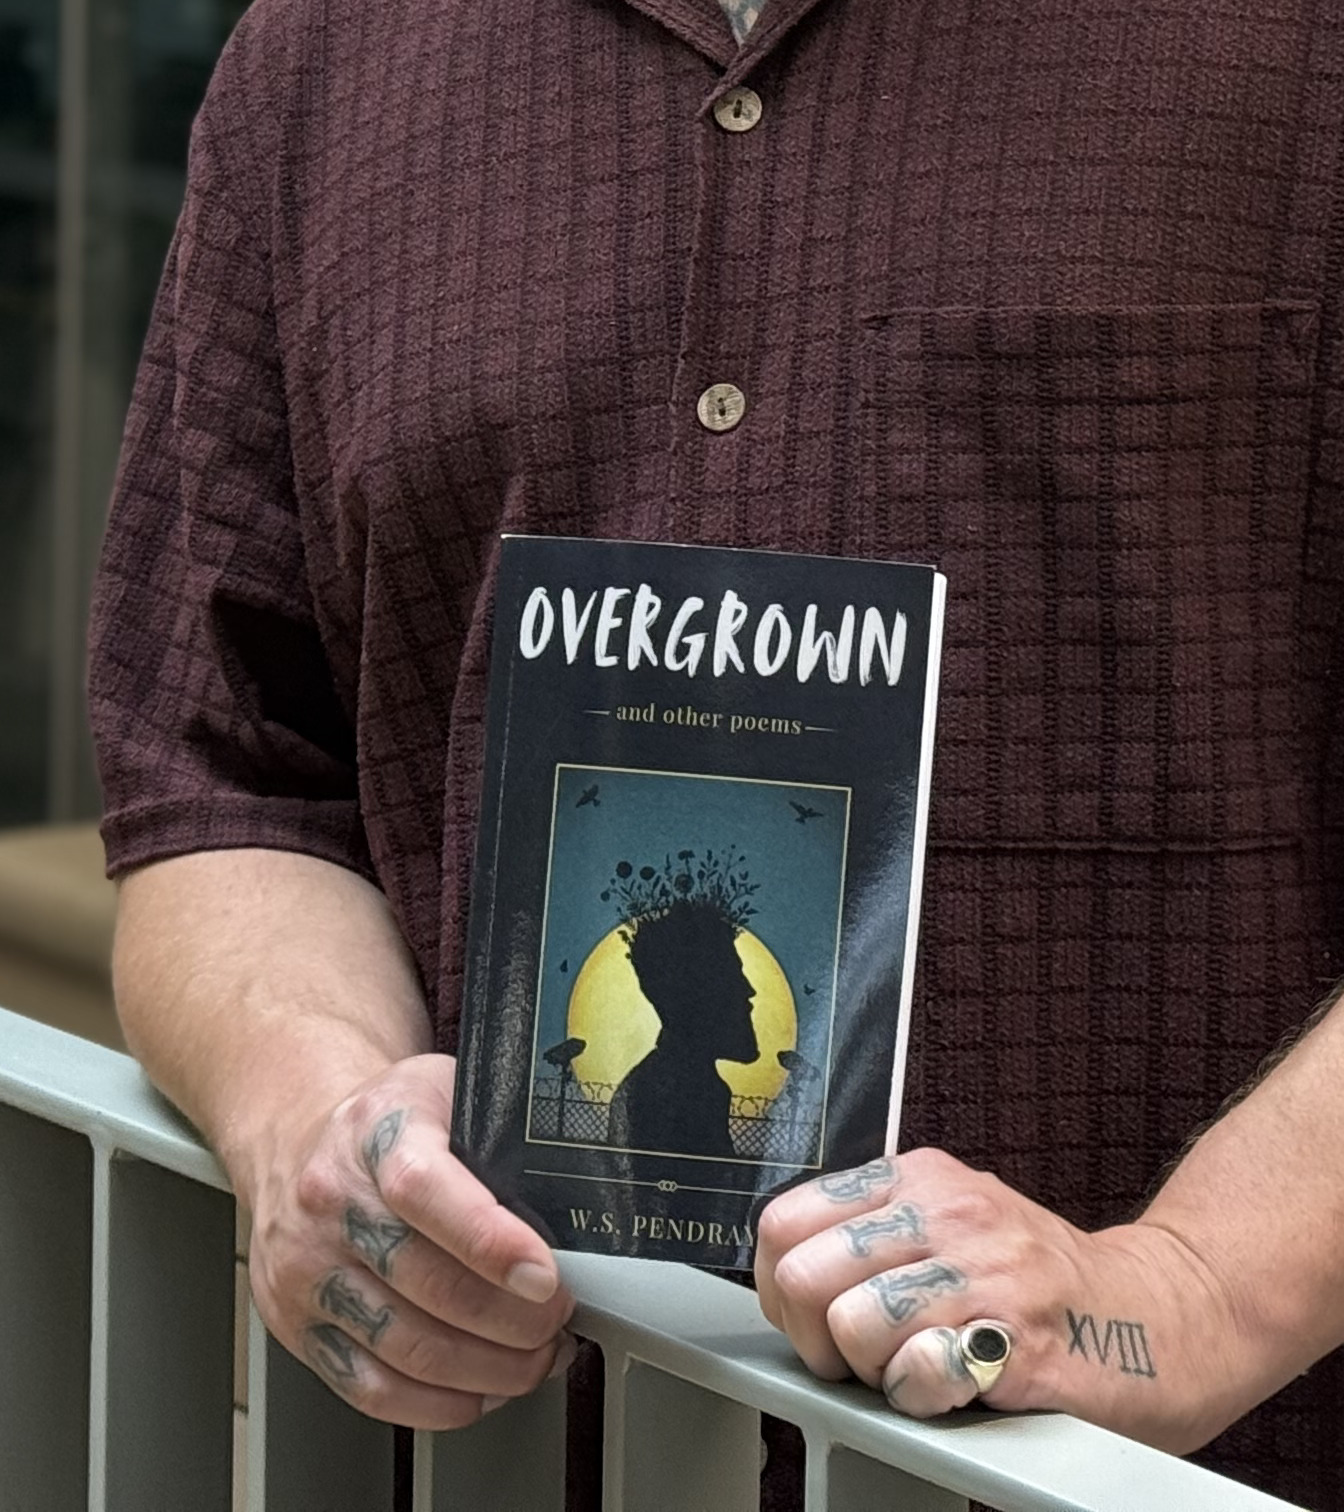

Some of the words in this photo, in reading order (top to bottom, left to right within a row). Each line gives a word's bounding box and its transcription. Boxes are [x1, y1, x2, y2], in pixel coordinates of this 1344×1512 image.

[518, 583, 908, 688] OVERGROWN
[615, 702, 656, 723] and
[662, 705, 724, 729] other
[729, 714, 803, 735] poems
[569, 1208, 621, 1236] W.S.
[1065, 1307, 1158, 1379] XVIII
